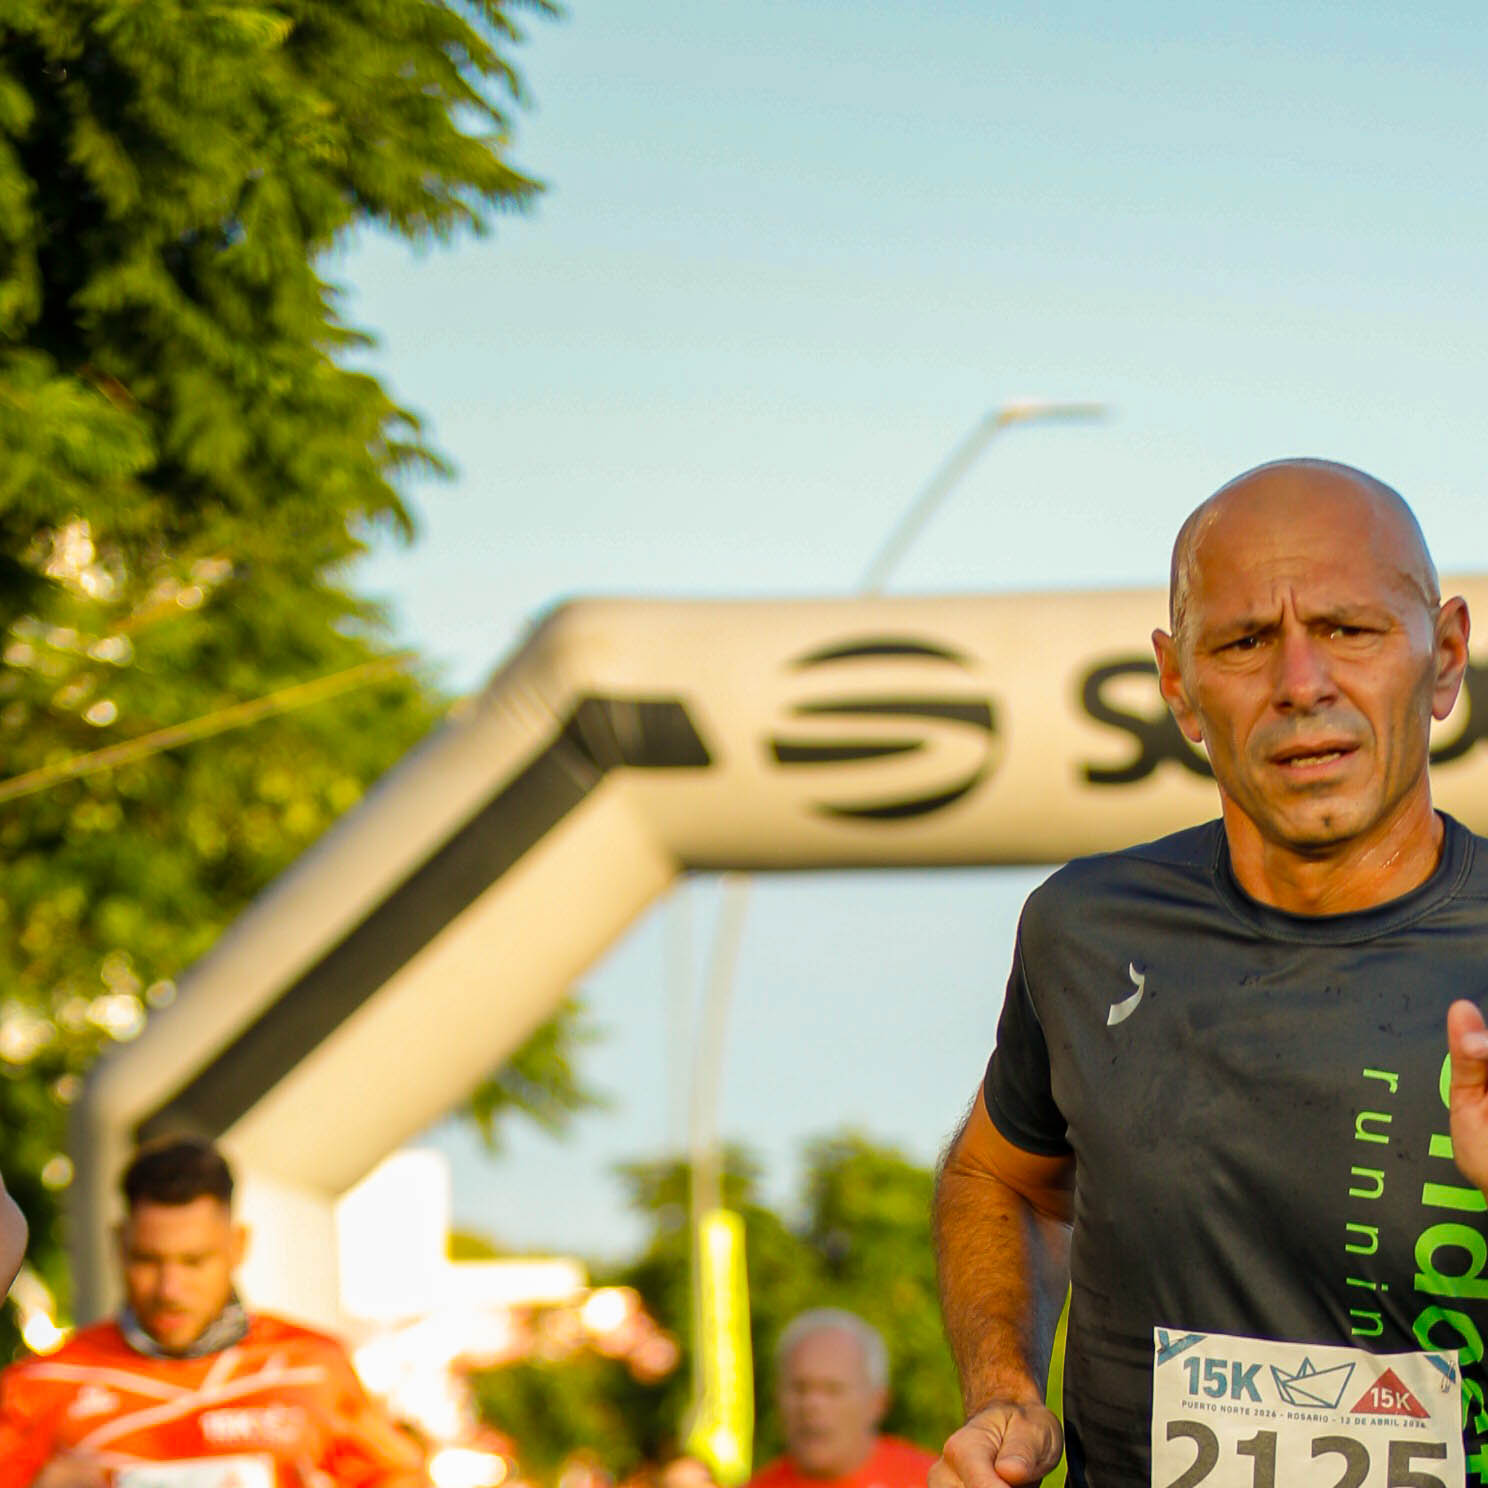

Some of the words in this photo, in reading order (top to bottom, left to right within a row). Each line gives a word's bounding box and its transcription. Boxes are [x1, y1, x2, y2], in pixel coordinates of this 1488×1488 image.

[1345, 1067, 1399, 1337] runnin
[1183, 1357, 1263, 1403] 15K
[1181, 1400, 1217, 1412] PUERTO
[1220, 1405, 1250, 1416] NORTE
[1254, 1408, 1277, 1418] 2026
[1287, 1411, 1329, 1423] ROSARIO
[1354, 1417, 1367, 1425] DE
[1370, 1418, 1400, 1427] ABRIL
[1370, 1387, 1412, 1411] 15K
